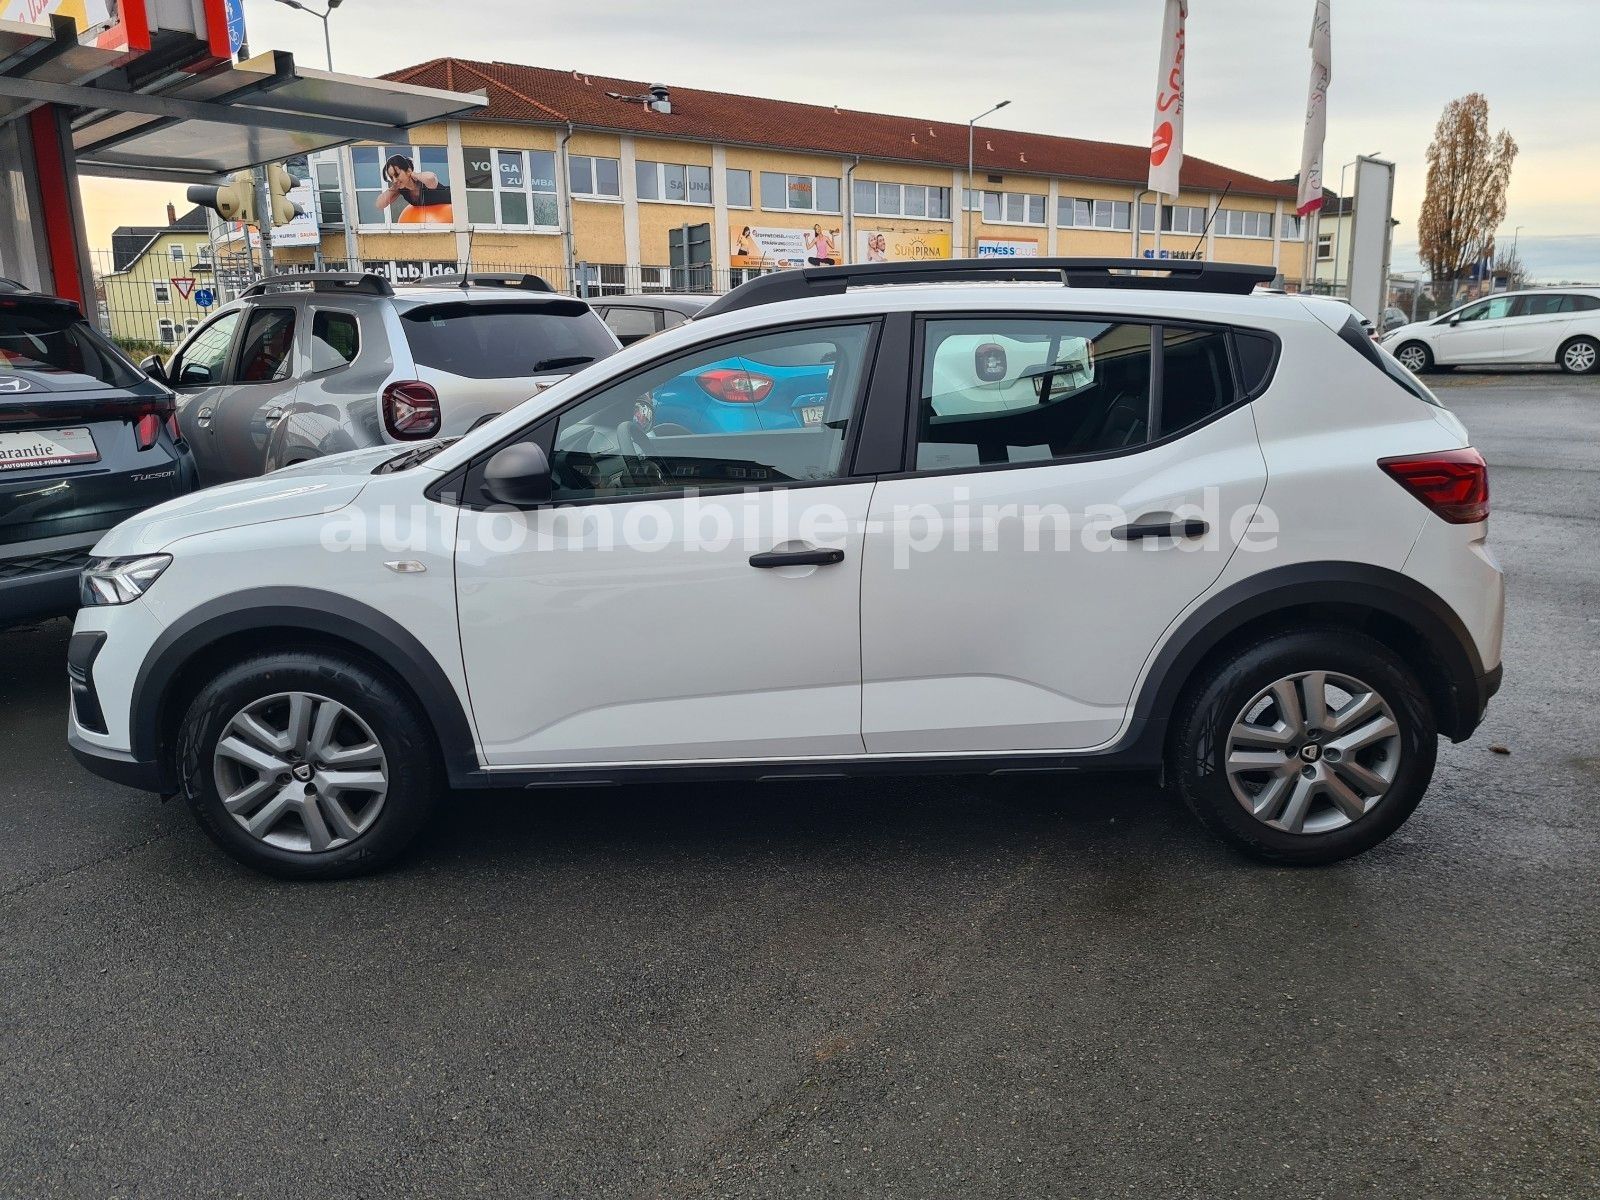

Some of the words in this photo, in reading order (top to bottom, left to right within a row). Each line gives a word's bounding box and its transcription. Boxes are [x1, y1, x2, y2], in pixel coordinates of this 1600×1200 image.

[471, 161, 519, 173] YOGA
[507, 177, 554, 186] ZUMBA
[670, 180, 711, 191] SAUNA
